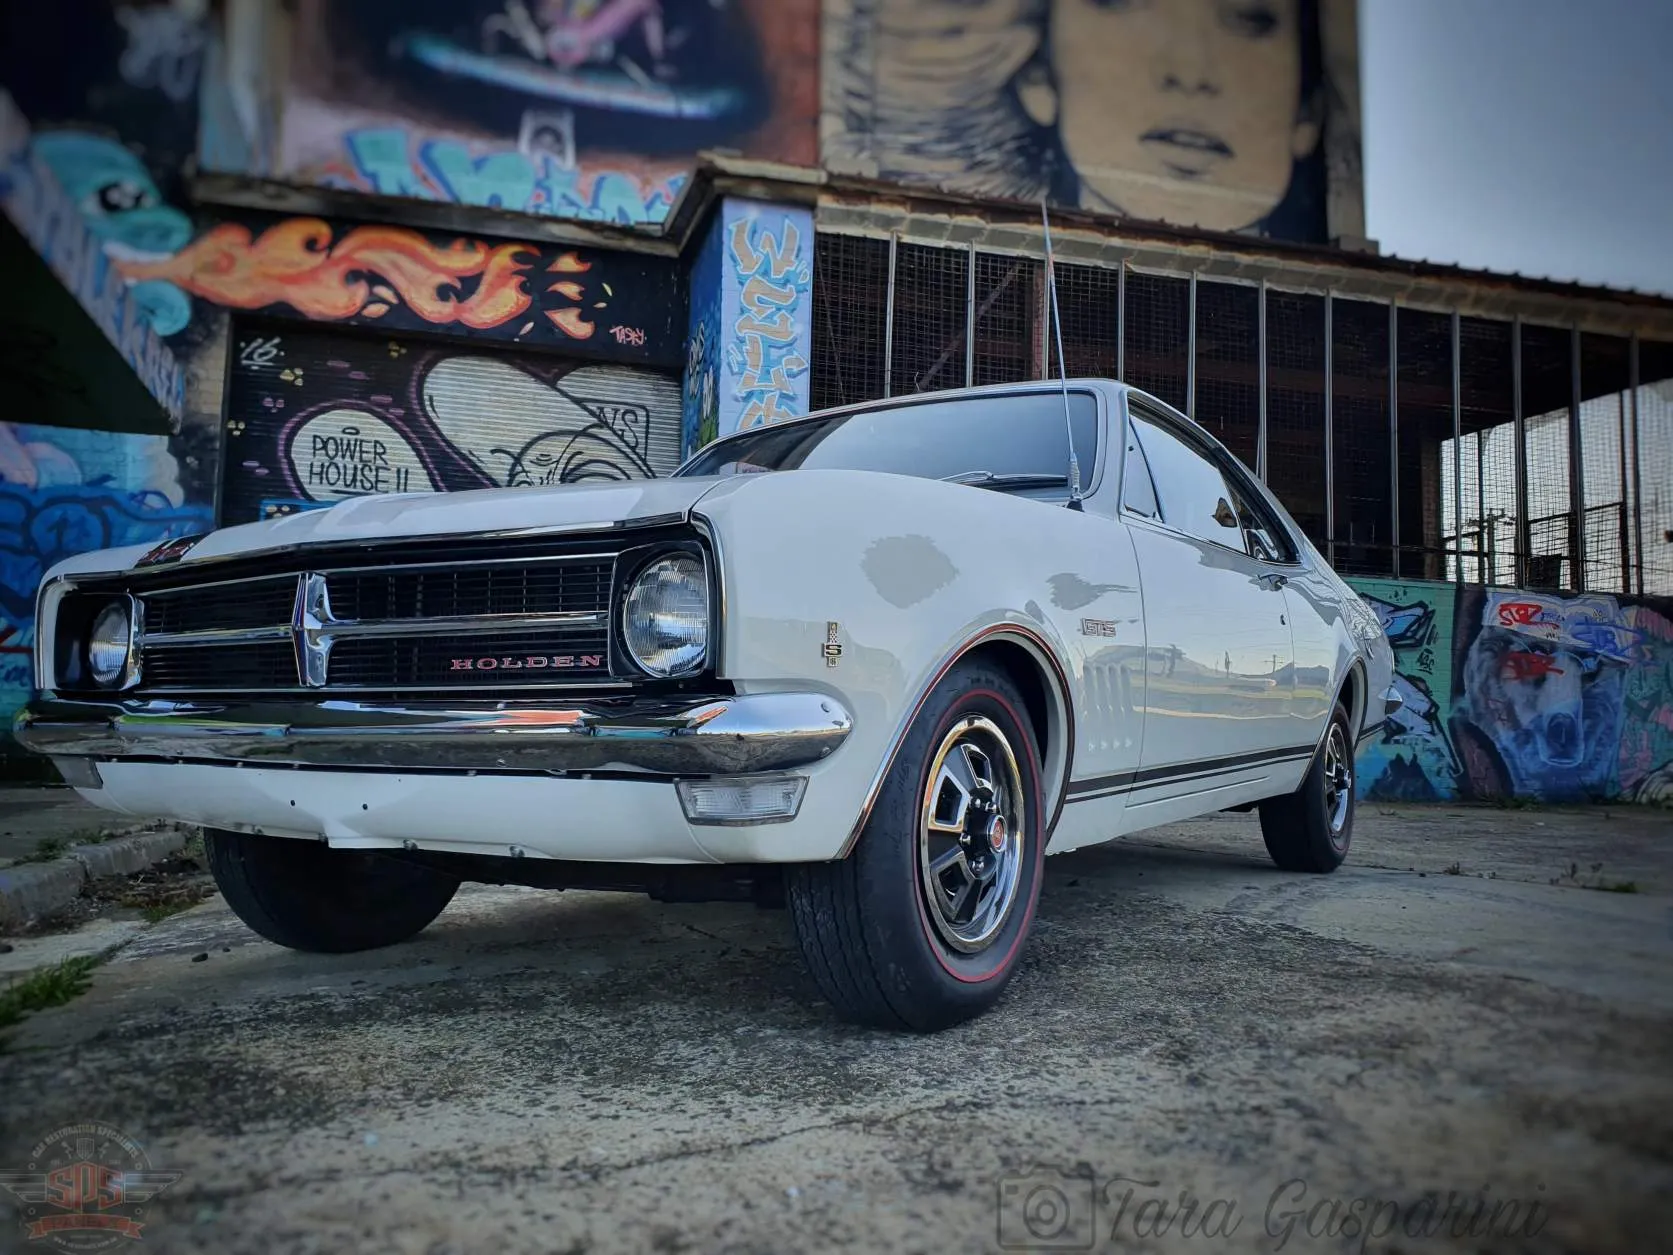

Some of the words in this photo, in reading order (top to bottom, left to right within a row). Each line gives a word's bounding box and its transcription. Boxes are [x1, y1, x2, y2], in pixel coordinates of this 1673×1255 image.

[312, 434, 389, 465] POWER
[1081, 617, 1117, 638] GTS
[450, 654, 604, 671] HOLDEN
